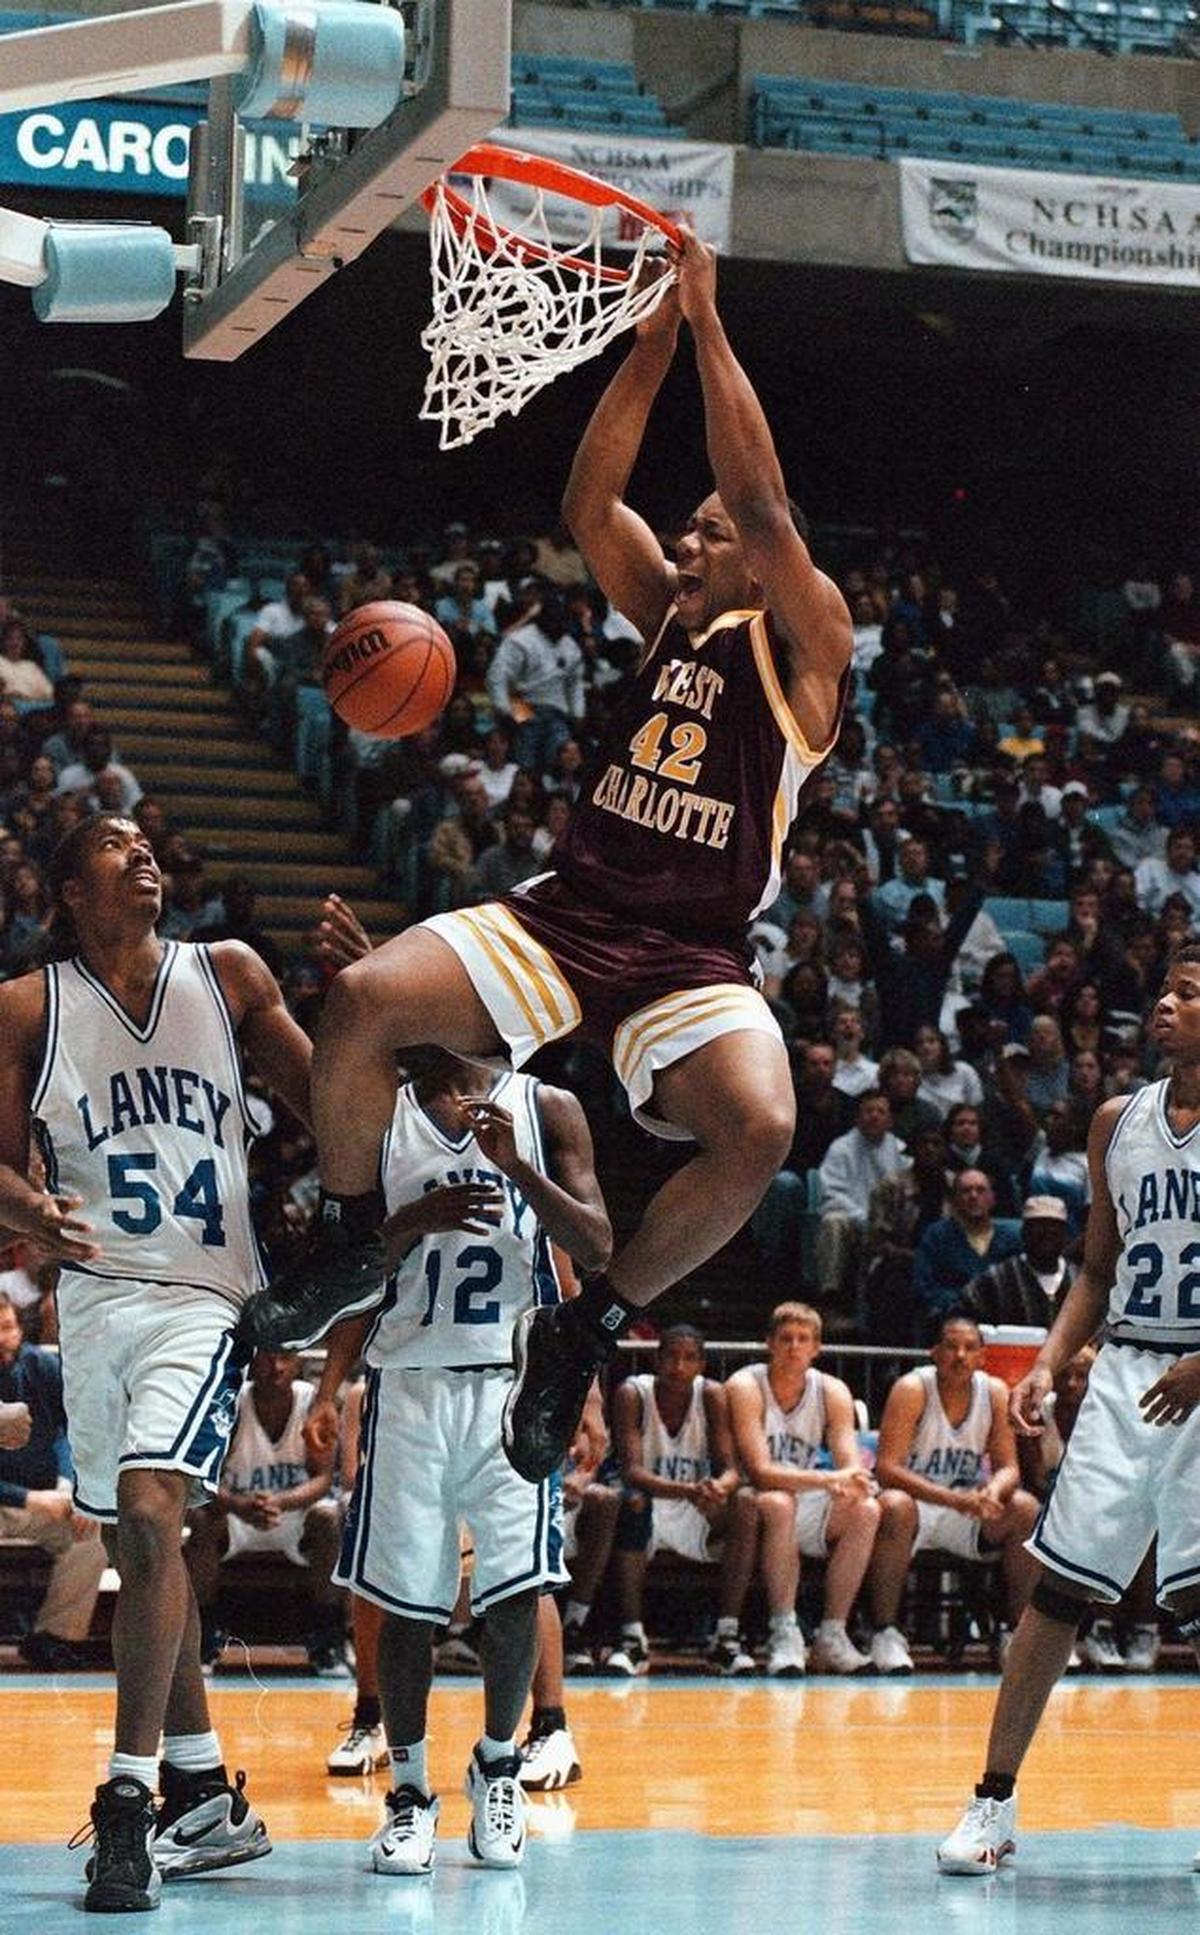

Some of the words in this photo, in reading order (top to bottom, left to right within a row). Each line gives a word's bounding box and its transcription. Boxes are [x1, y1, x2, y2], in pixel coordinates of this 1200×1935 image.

[16, 113, 299, 187] CAROIN
[1005, 229, 1200, 270] Championshi
[628, 711, 707, 786] 42
[76, 1066, 231, 1152] LANEY
[107, 1152, 226, 1248] 54
[419, 1245, 504, 1327] 12
[1124, 1242, 1200, 1319] 22
[229, 1462, 308, 1493] LANE
